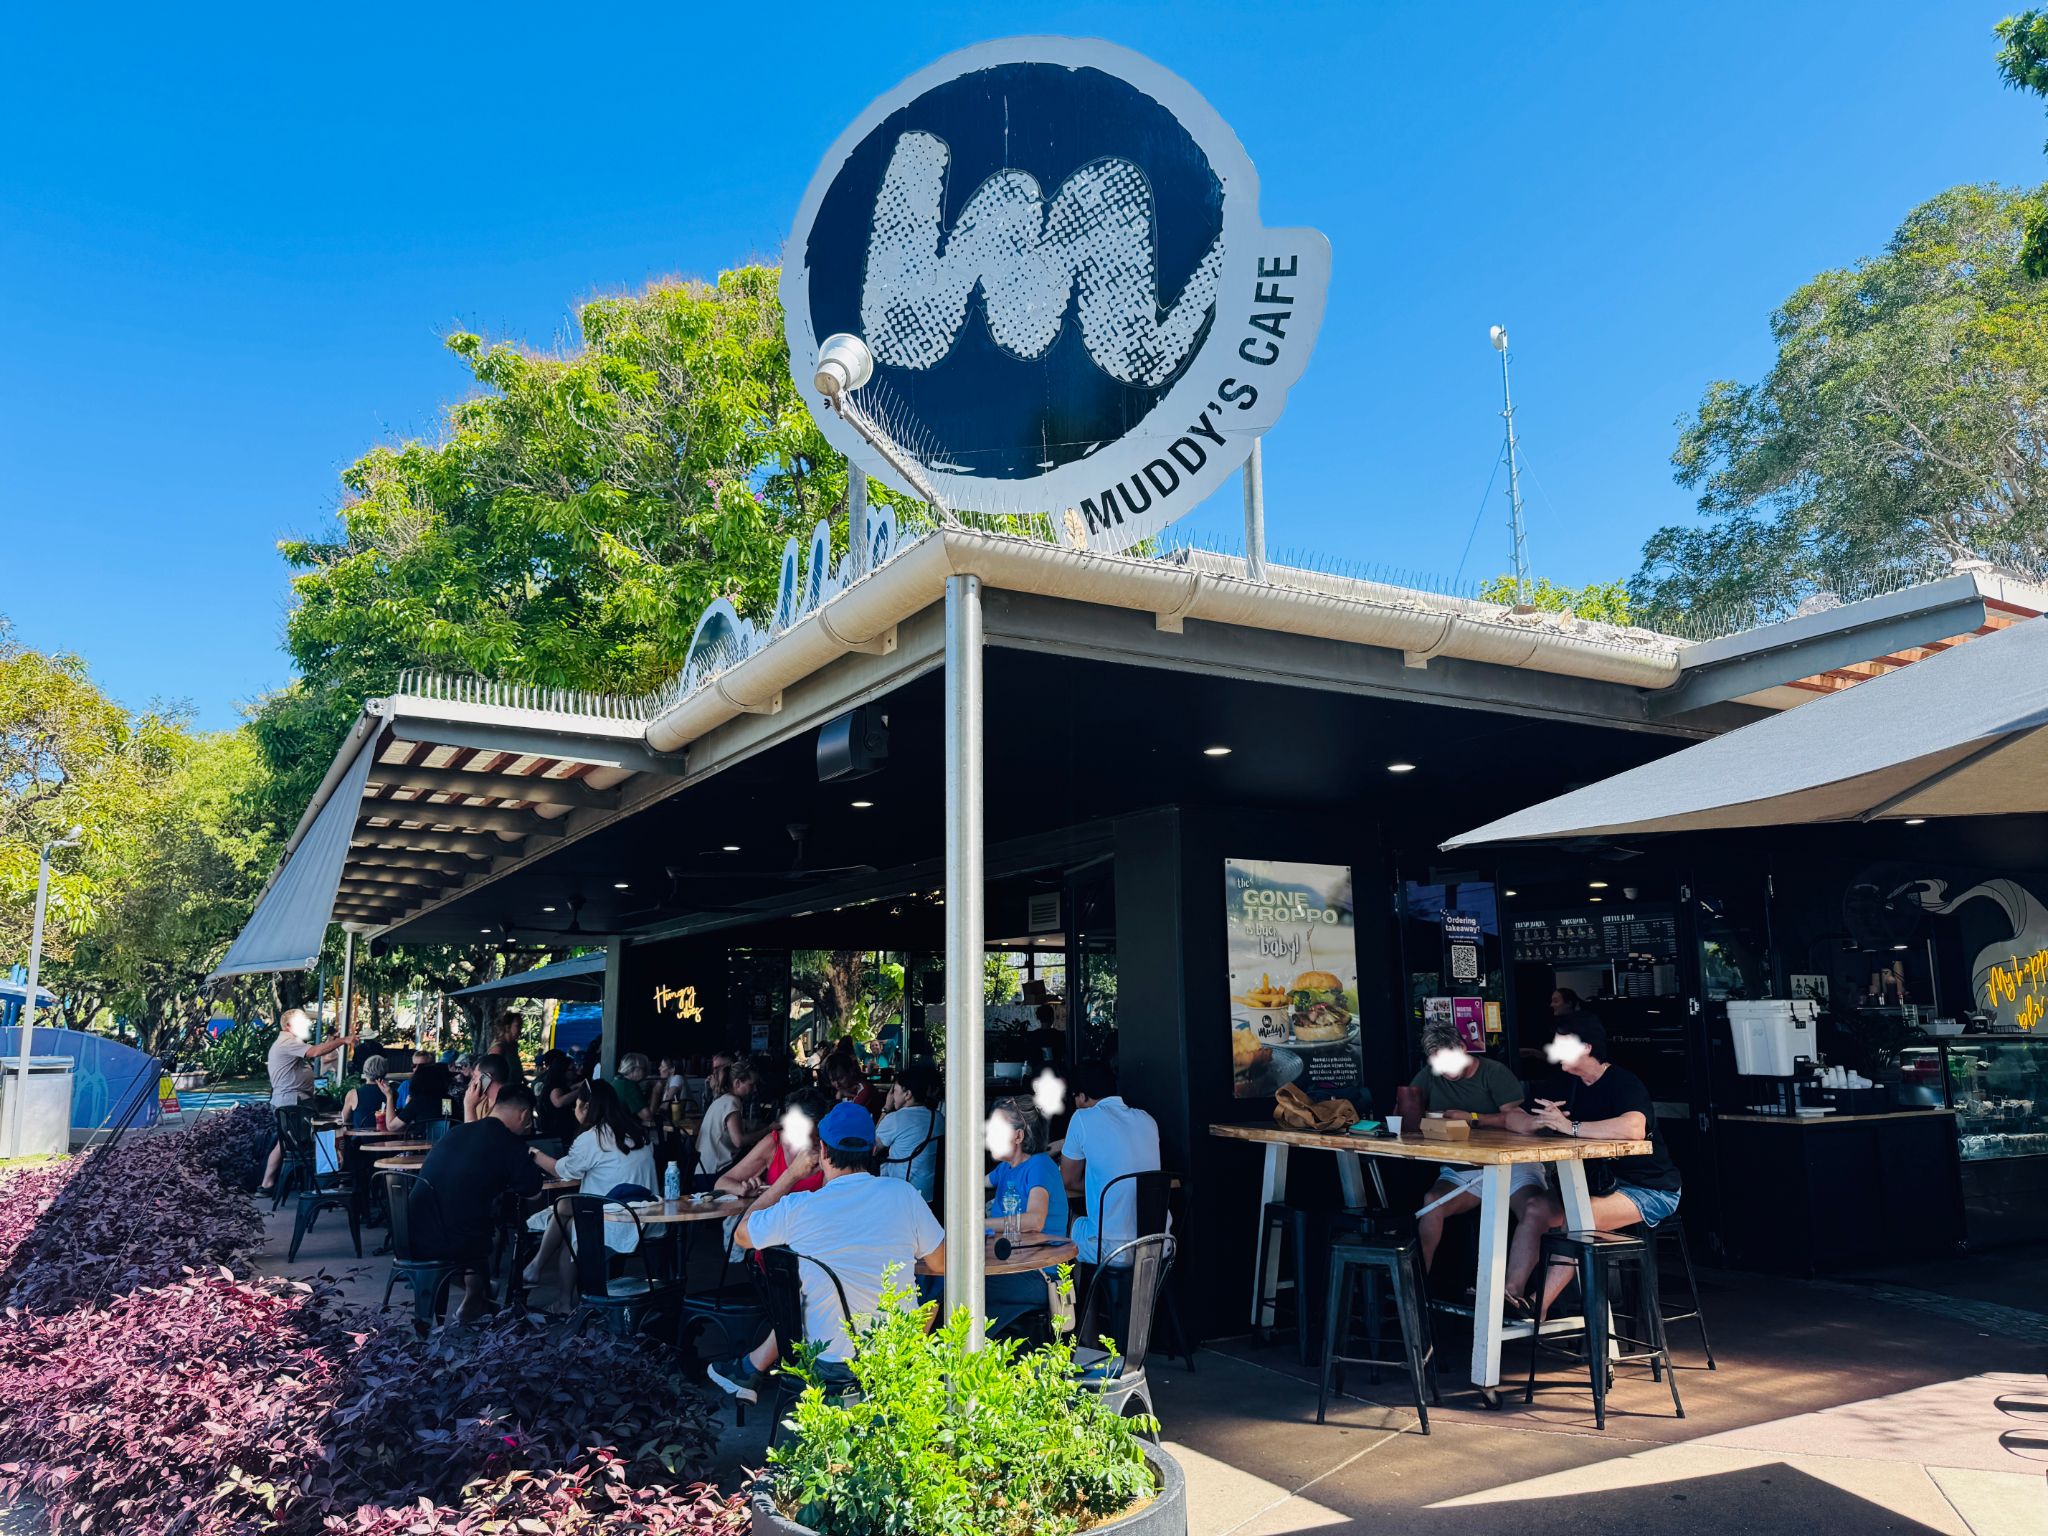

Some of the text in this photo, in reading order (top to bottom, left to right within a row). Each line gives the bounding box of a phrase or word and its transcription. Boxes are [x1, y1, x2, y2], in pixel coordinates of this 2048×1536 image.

[1080, 255, 1298, 536] MUDDY'S CAFE
[1243, 889, 1309, 908] GONE
[1243, 905, 1339, 924] TROPPO
[1446, 916, 1476, 926] Ordering
[1445, 925, 1480, 934] takeaway?
[1260, 934, 1299, 965] baby!
[1985, 949, 2048, 1008] My happ
[653, 984, 697, 1013] Hungry
[2015, 994, 2046, 1030] pla
[1257, 1023, 1286, 1038] Muddy's
